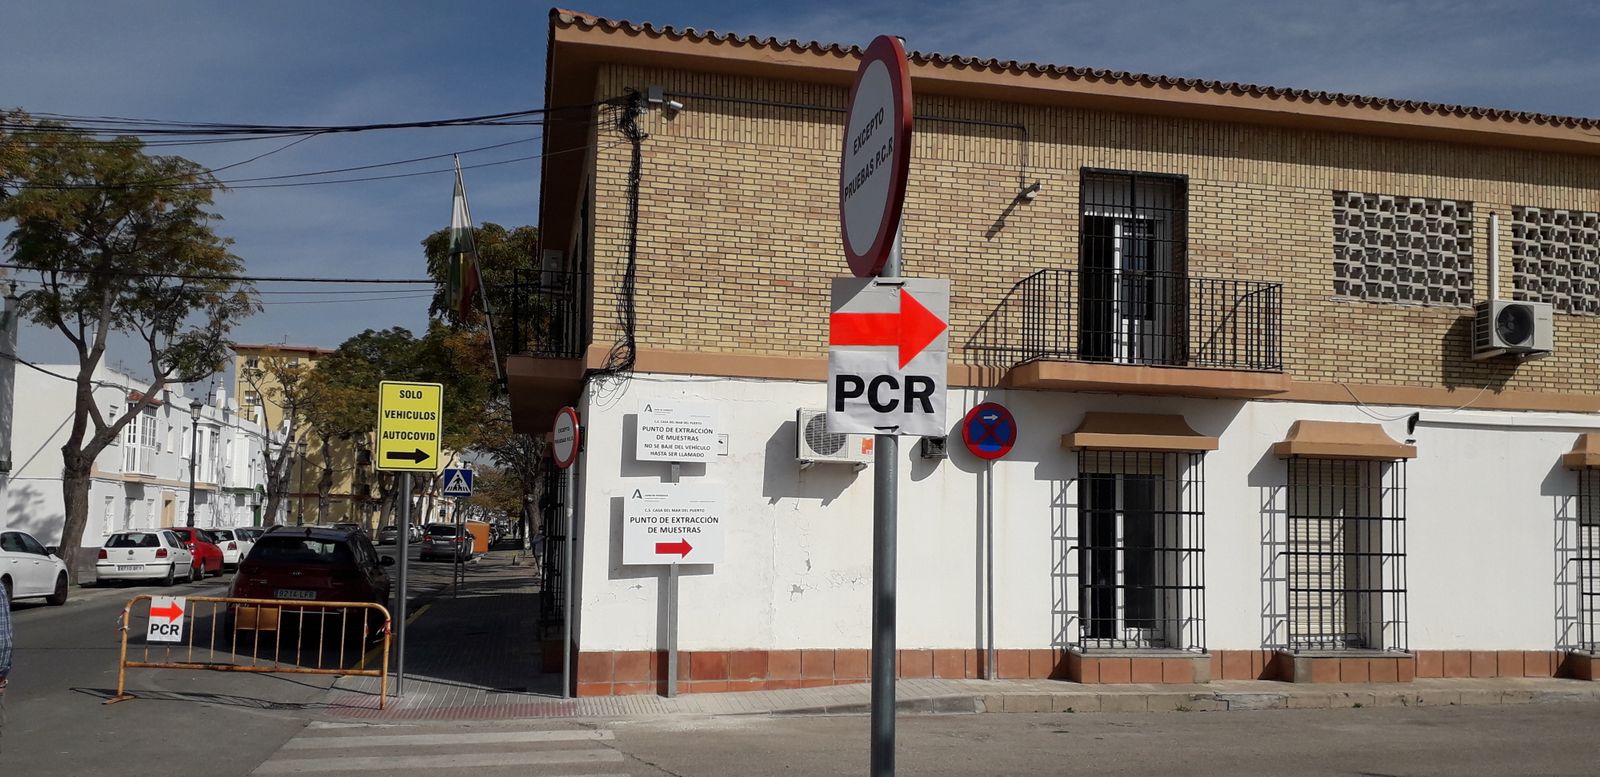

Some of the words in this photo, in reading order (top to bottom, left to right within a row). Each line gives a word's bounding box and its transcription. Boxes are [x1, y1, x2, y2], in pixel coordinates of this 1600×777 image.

[853, 107, 885, 156] EXCEPTO
[844, 158, 874, 202] PRUEBAS
[399, 389, 423, 400] SOLO
[835, 374, 936, 414] PCR
[384, 410, 436, 421] VEHICULOS
[642, 425, 665, 433] PUNTO
[675, 426, 714, 434] EXTRACCIÓN
[382, 430, 436, 441] AUTOCOVID
[665, 434, 699, 442] MUESTRAS
[629, 516, 658, 524] PUNTO
[659, 516, 669, 524] DE
[671, 515, 719, 524] EXTRACCIÓN
[647, 526, 658, 534] DE
[659, 526, 702, 534] MUESTRAS
[150, 623, 180, 636] PCR
